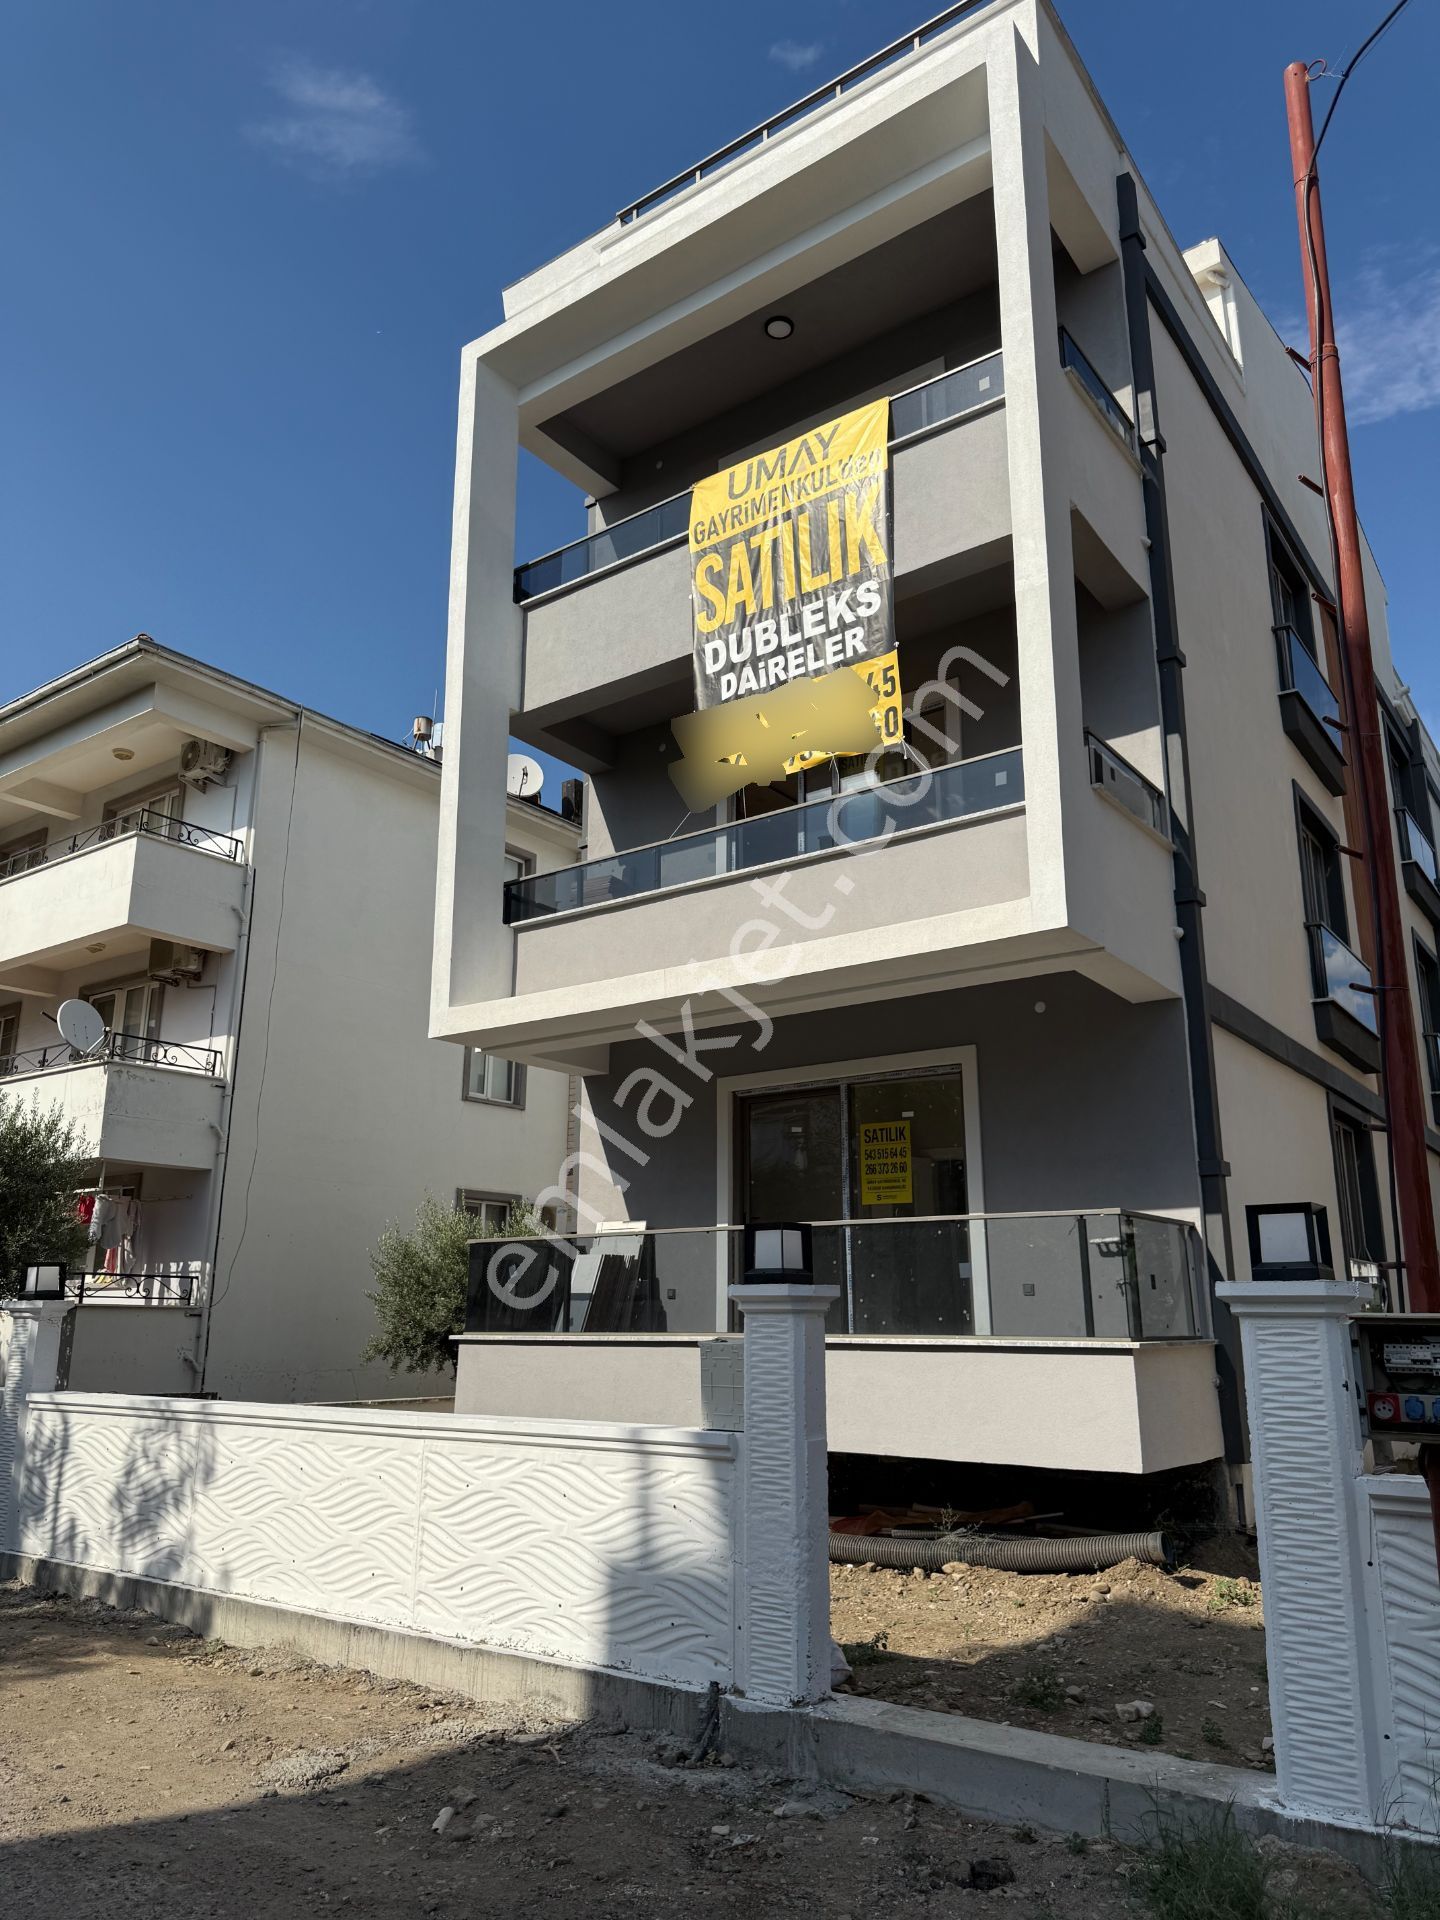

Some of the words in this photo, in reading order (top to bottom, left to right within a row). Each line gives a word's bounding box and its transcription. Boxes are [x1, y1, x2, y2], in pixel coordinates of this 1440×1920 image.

[728, 423, 841, 501] UMAY
[695, 483, 888, 633] SATILIK
[704, 580, 882, 674] DUBLEKS
[864, 1126, 906, 1144] SATILIK
[864, 1148, 876, 1160] 543
[877, 1147, 889, 1160] 515
[899, 1146, 907, 1159] 45
